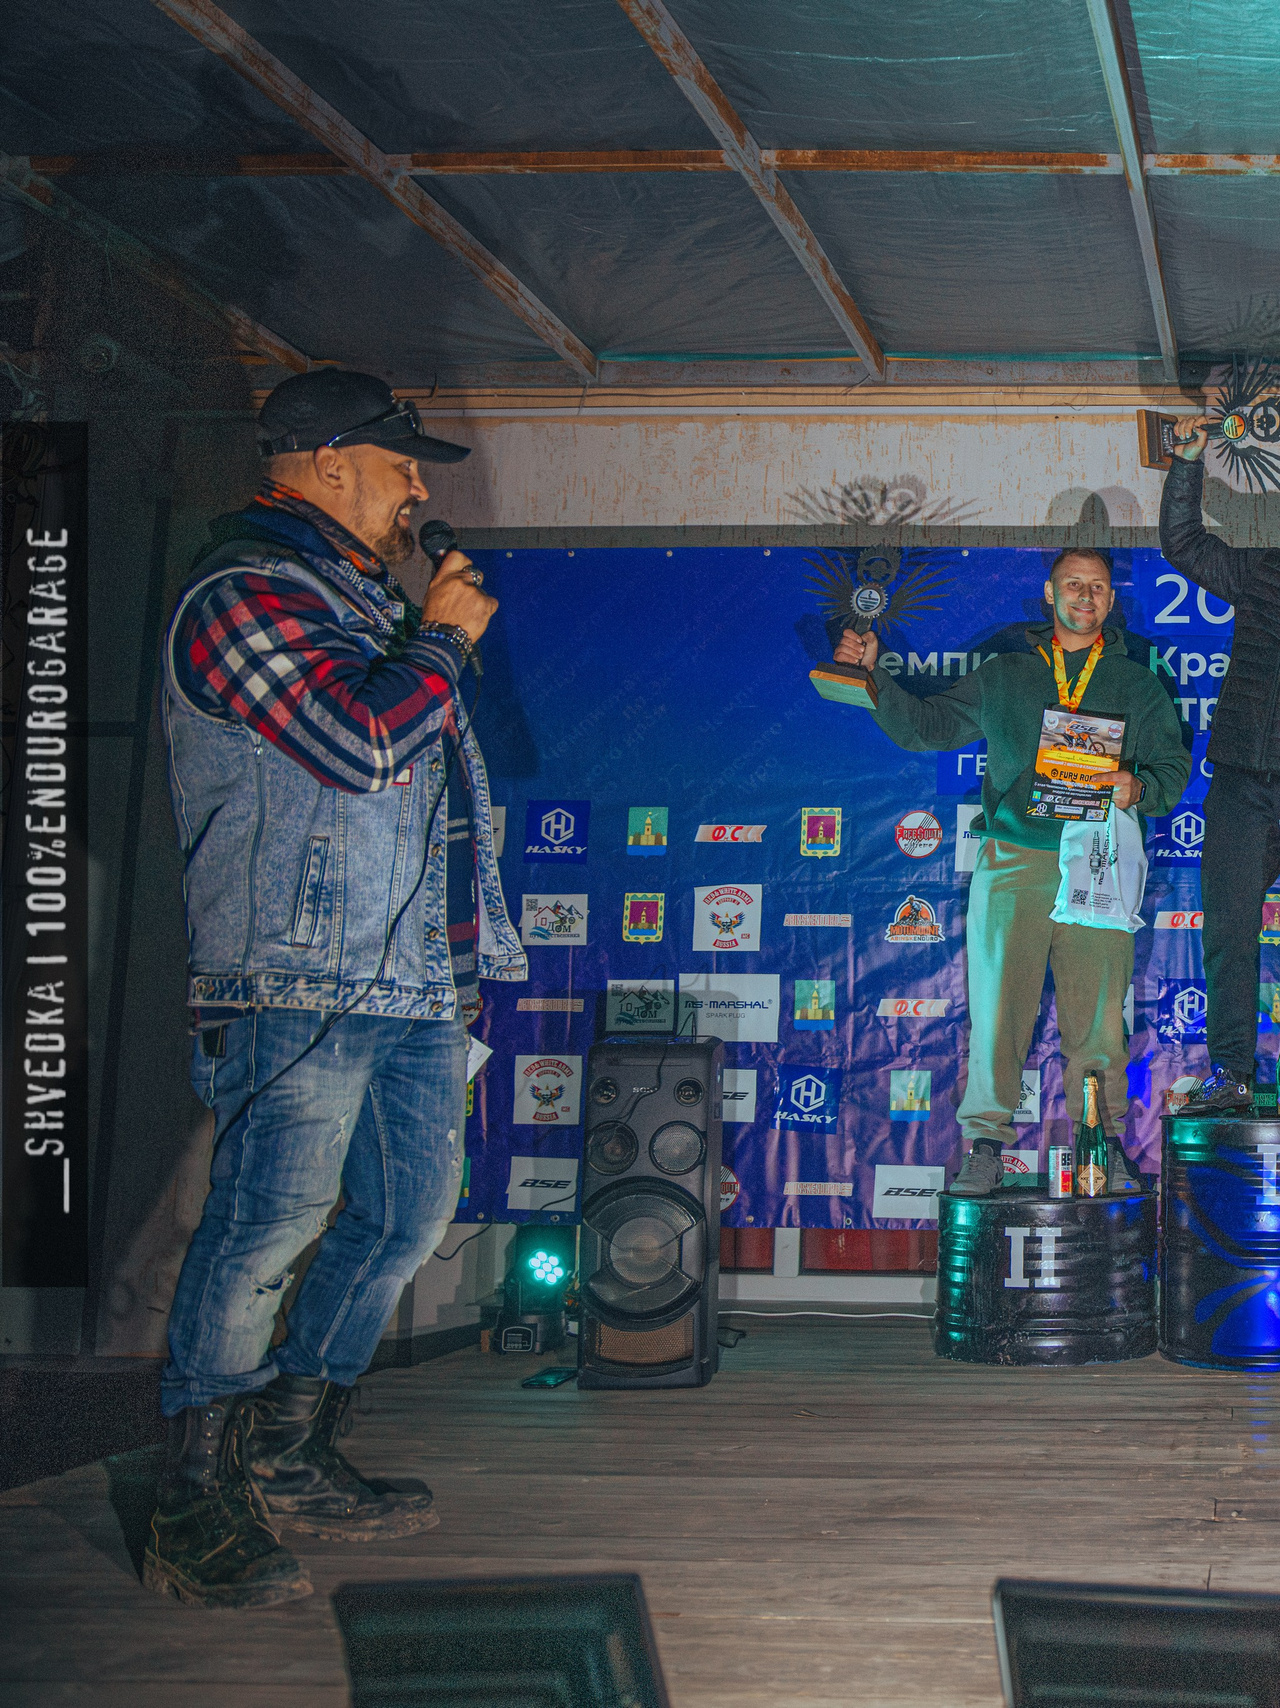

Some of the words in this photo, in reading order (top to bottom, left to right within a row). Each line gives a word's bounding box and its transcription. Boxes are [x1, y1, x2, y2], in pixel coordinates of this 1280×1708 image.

[1059, 771, 1079, 780] FURY
[1080, 773, 1094, 782] RO
[525, 845, 588, 855] HASKY
[1156, 849, 1202, 858] HASK
[546, 921, 571, 933] Дом
[633, 1006, 658, 1018] Дом
[1158, 1024, 1208, 1034] HASK
[773, 1110, 837, 1124] HASKY
[518, 1178, 572, 1189] BSE
[882, 1187, 938, 1197] BSE
[1004, 1226, 1061, 1289] II
